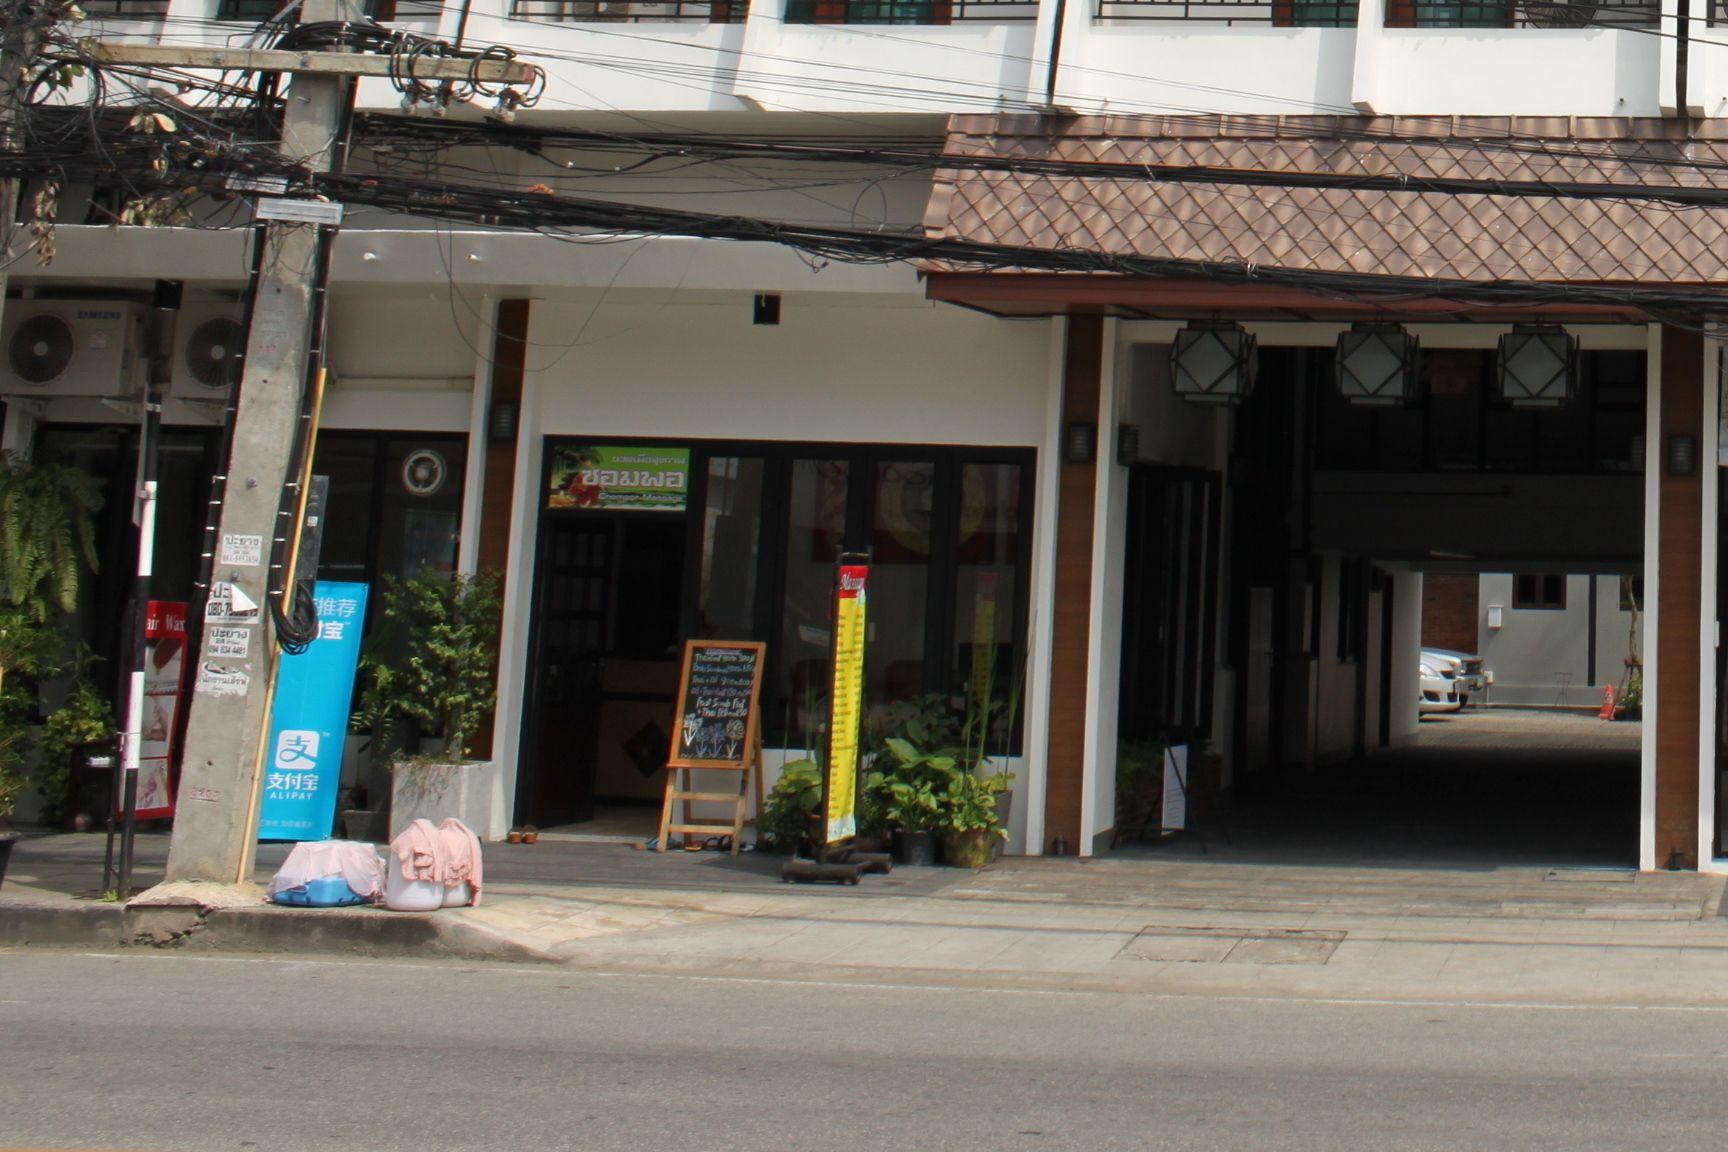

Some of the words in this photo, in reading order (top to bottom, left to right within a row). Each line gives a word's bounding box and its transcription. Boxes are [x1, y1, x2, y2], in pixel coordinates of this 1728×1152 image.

[146, 613, 160, 631] air
[266, 772, 319, 791] 支付宝
[269, 791, 313, 800] ALIPAY
